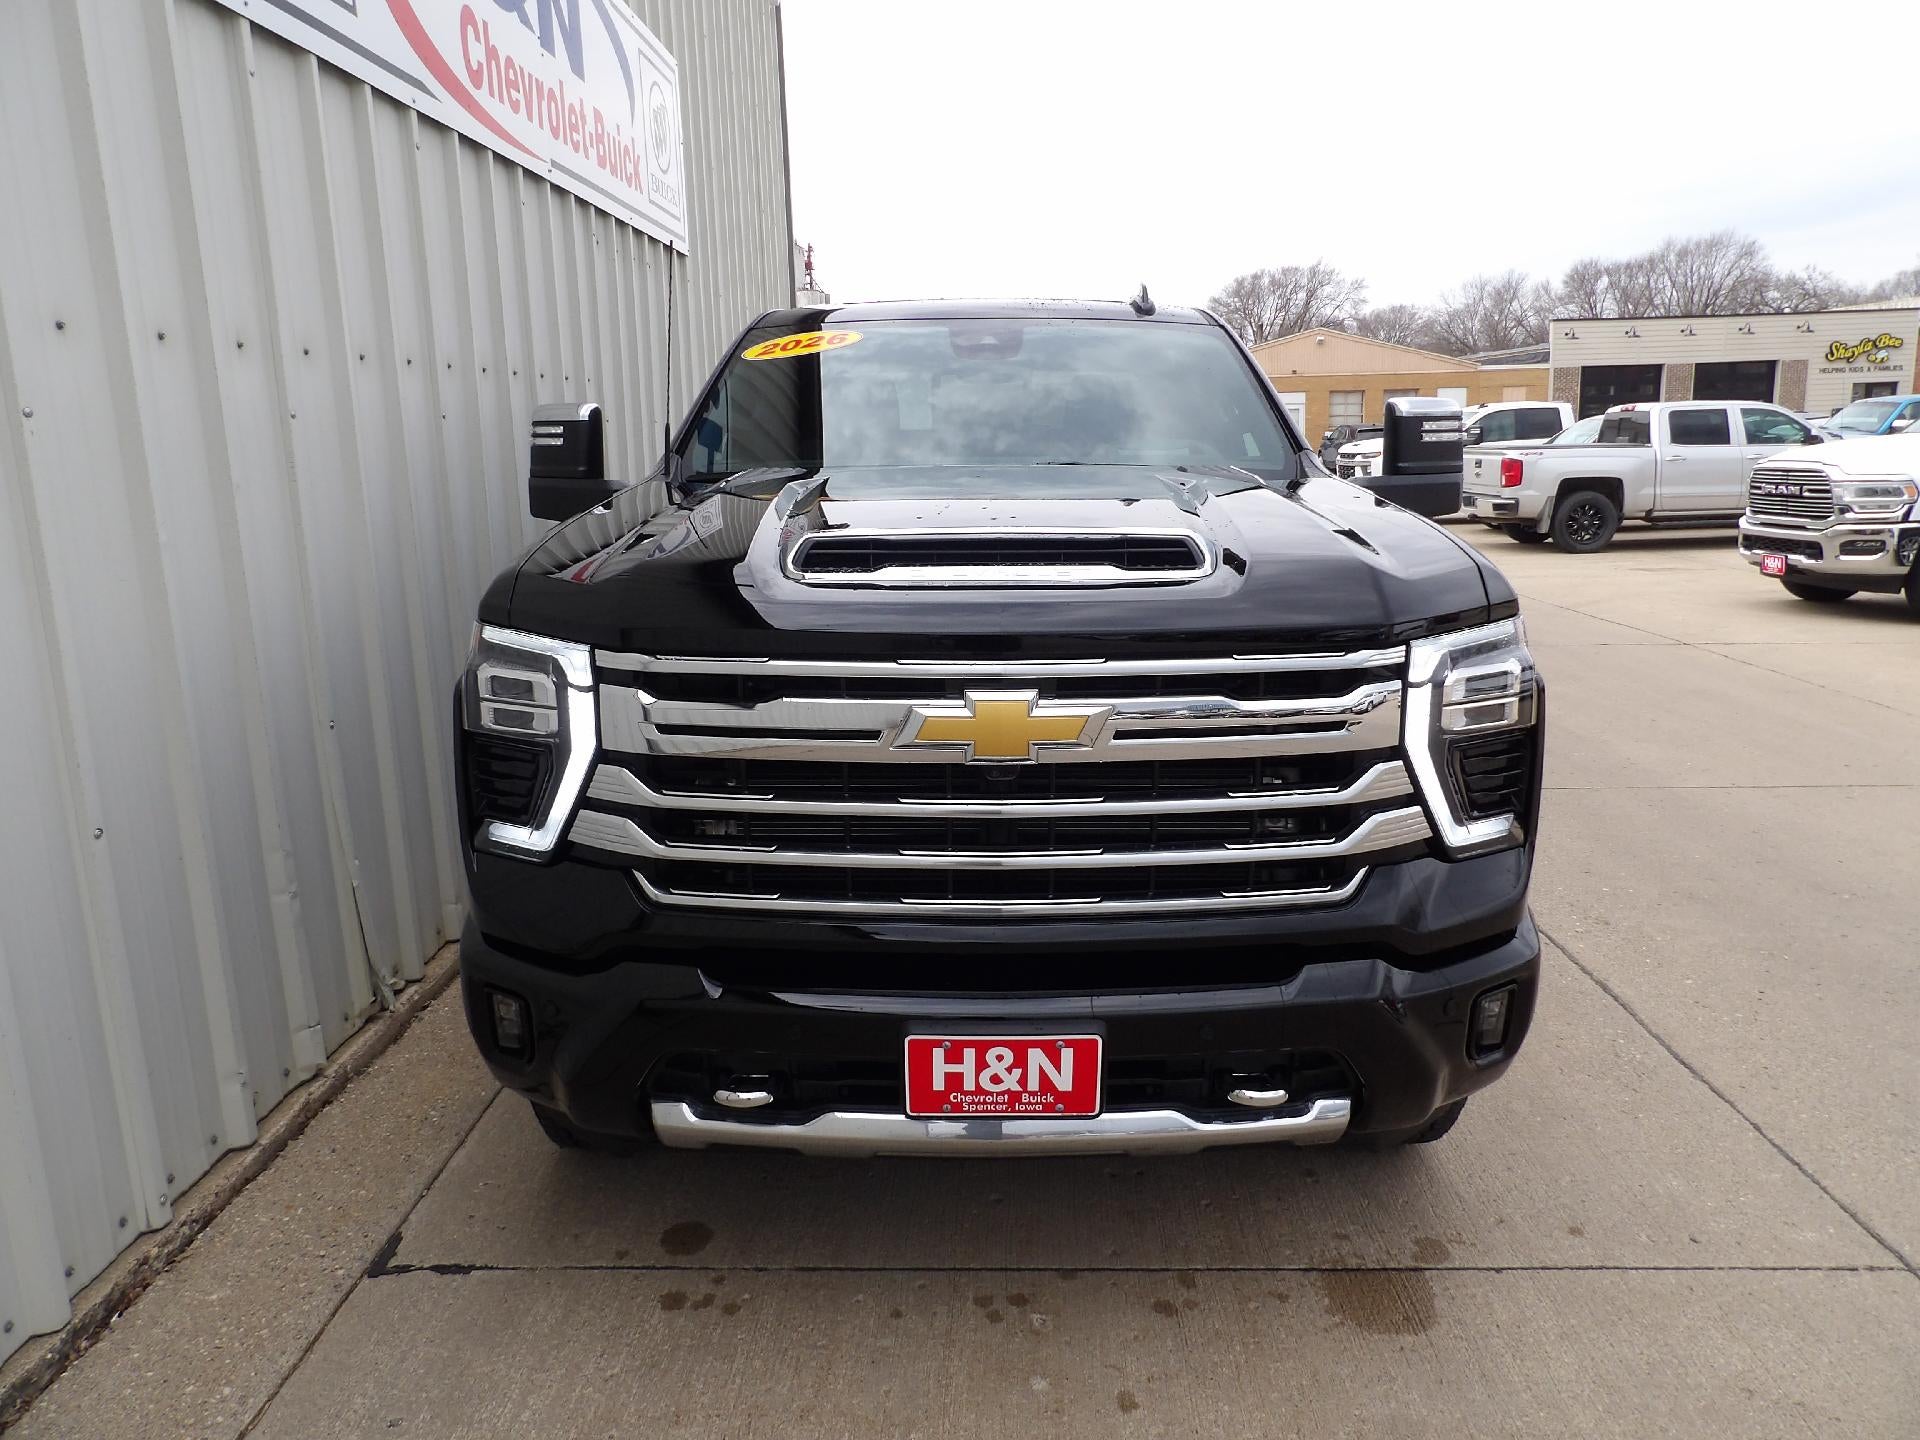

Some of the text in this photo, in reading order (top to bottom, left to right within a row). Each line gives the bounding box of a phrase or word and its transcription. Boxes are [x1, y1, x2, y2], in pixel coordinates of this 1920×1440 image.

[1826, 333, 1903, 363] Shayla Bee
[1874, 364, 1904, 372] FAMILIES
[1764, 485, 1801, 495] RAM
[1764, 556, 1782, 569] H&N
[932, 1047, 1074, 1092] H&N
[950, 1092, 1054, 1103] Chevrolet Buick
[962, 1102, 1043, 1112] Spencer, Iowa
